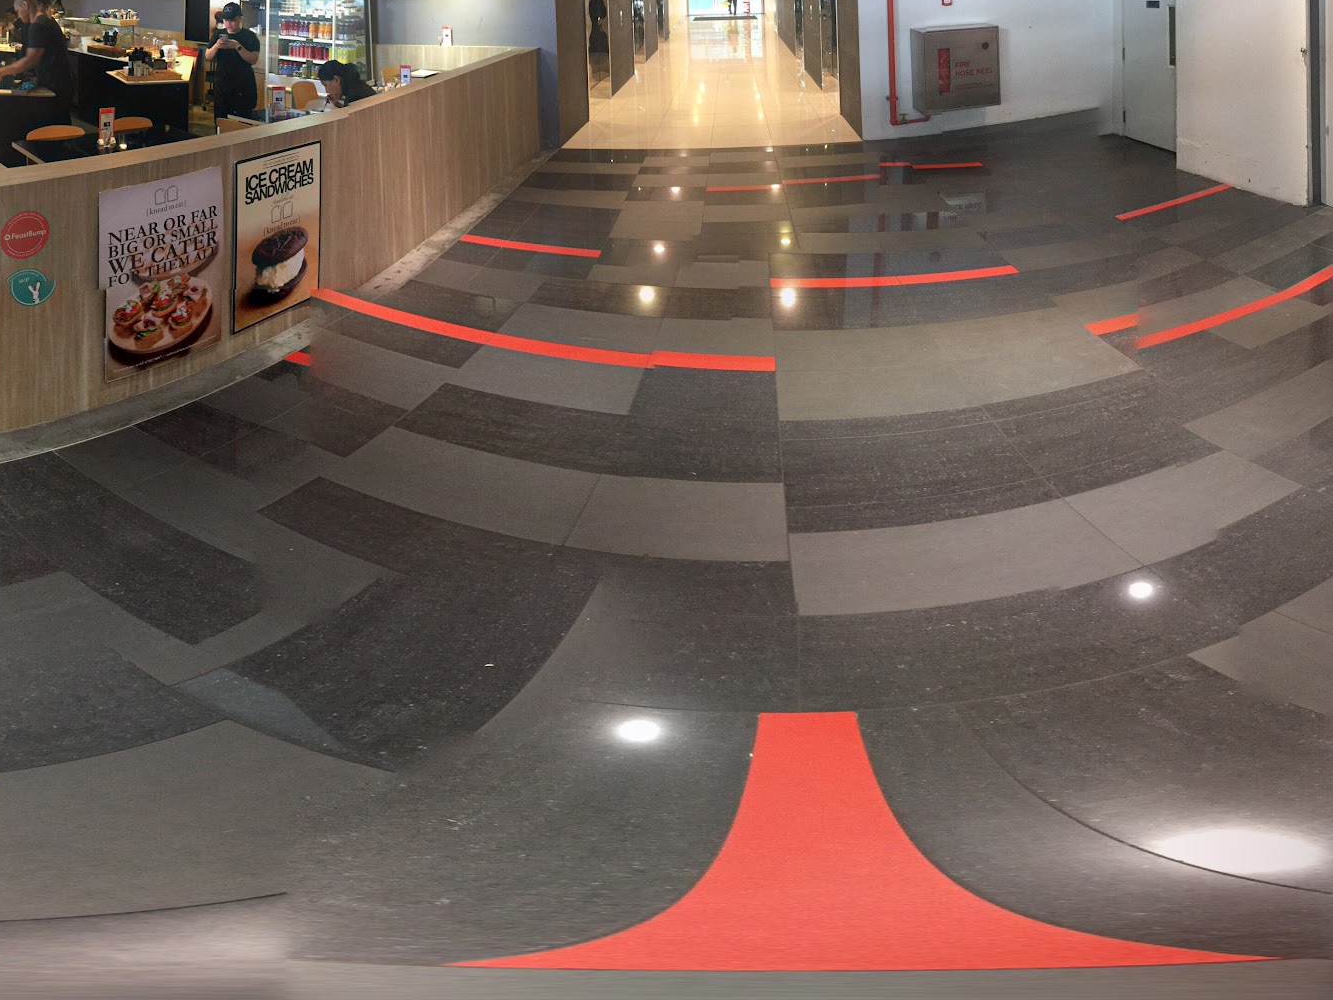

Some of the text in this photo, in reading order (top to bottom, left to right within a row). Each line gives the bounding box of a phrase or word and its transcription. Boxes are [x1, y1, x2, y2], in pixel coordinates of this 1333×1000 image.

[245, 172, 267, 192] ICE
[269, 158, 313, 184] CREAM
[245, 173, 314, 205] SANDWICHES
[11, 230, 46, 239] FeastBump
[108, 205, 218, 245] NEAR OR FAR
[108, 219, 218, 258] BIG OR SMALL
[108, 231, 217, 274] WE CATER
[145, 255, 190, 277] THEM
